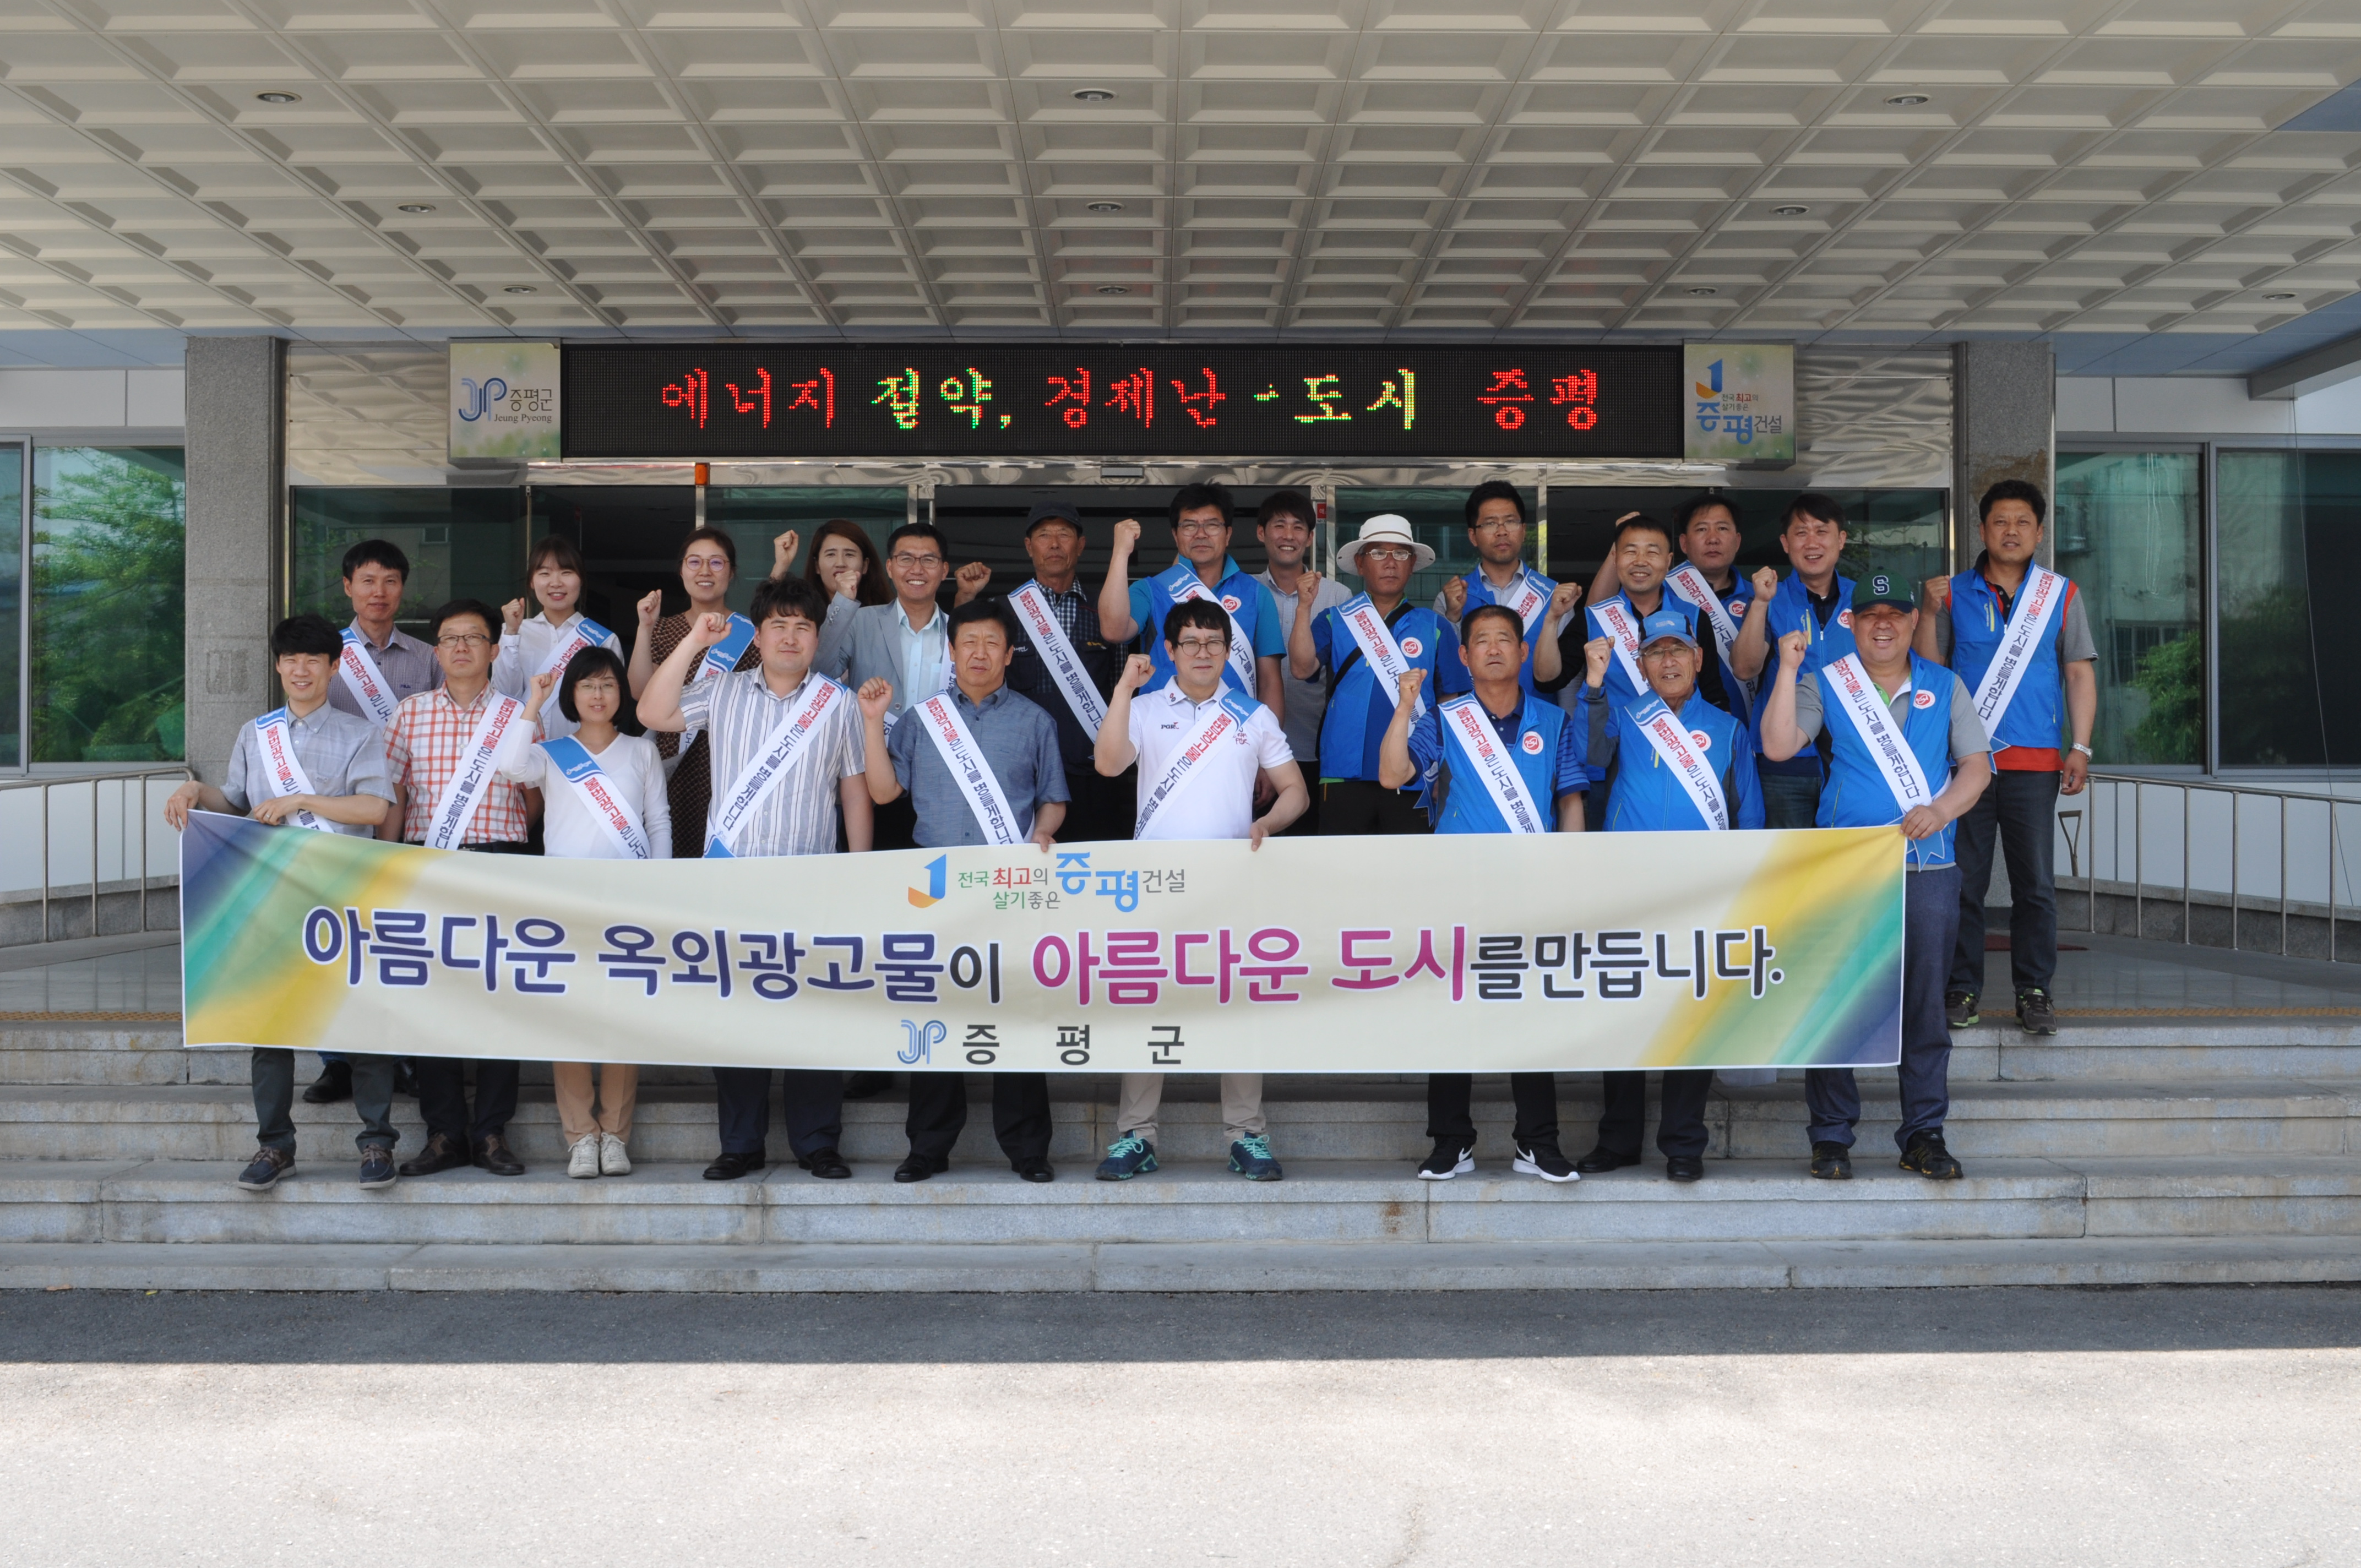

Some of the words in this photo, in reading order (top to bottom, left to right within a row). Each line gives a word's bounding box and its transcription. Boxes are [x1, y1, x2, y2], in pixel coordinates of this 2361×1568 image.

[494, 413, 519, 423] Jeung
[521, 414, 552, 423] Pyeong
[510, 389, 552, 412] 증평군
[662, 367, 834, 429] 에너지
[871, 367, 1011, 429] 절약,
[1045, 367, 1226, 429] 경제난
[1477, 368, 1598, 430] 증평
[1721, 394, 1735, 402] 전국
[1736, 393, 1759, 402] 최고의
[1873, 575, 1890, 595] S
[2024, 572, 2054, 627] 불법광고물은
[1019, 590, 1056, 645] 불법광고물은
[1048, 643, 1074, 674] 도시를
[1354, 610, 1394, 667] 불법광고물은
[2009, 624, 2033, 658] 도시를
[790, 682, 836, 739] 불법광고물은
[1978, 656, 2017, 721] 병들게합니다
[477, 698, 518, 758] 불법광고물은
[765, 734, 797, 771] 도시를
[1177, 713, 1232, 772] 불법광고물은
[1456, 706, 1500, 768] 불법광고물은
[1491, 765, 1519, 802] 도시를
[1858, 701, 1885, 736] 도시를
[1876, 733, 1921, 799] 병들게합니다
[266, 725, 299, 792] 불법광고물은
[460, 758, 486, 795] 도시를
[926, 697, 964, 752] 불법광고물은
[955, 749, 983, 784] 도시를
[973, 781, 1014, 845] 병들게합니
[1154, 766, 1183, 802] 도시를
[1652, 717, 1702, 779] 불법광고물은
[1694, 776, 1721, 813] 도시를
[435, 793, 469, 850] 병들게합니
[584, 777, 634, 841] 불법광고물은
[722, 765, 773, 832] 병들게합니다
[957, 870, 990, 889] 전국
[992, 867, 1048, 889] 최고의
[1142, 868, 1186, 894] 건설
[304, 908, 576, 994] 아름다운
[597, 924, 1001, 1004] 옥외광고물이
[1032, 927, 1309, 1006] 아름다운
